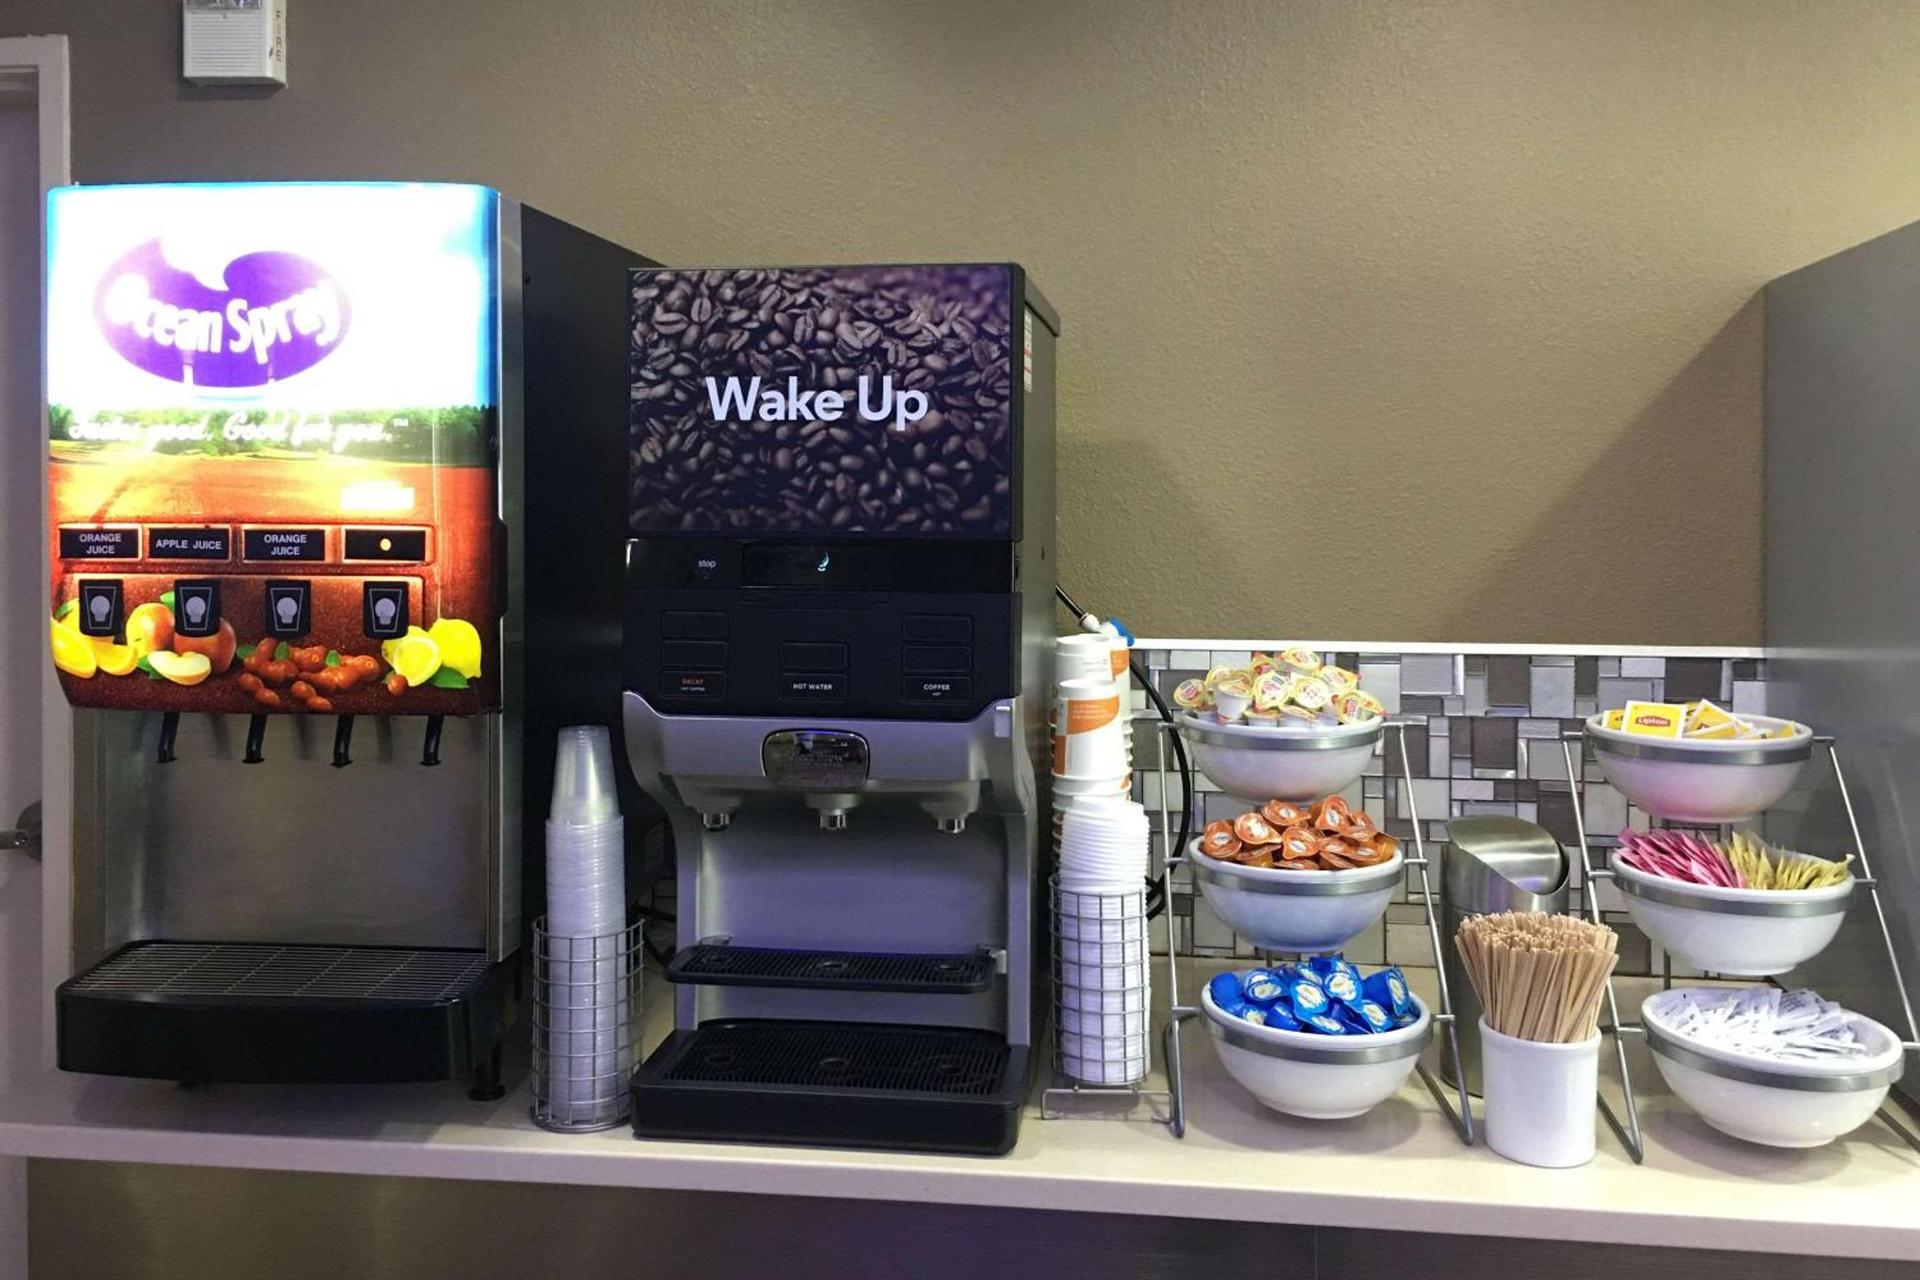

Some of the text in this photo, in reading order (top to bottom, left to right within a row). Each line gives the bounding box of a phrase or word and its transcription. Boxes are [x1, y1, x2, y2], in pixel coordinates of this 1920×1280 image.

[104, 272, 340, 365] Ocean Spray
[705, 375, 929, 431] Wake Up
[79, 533, 122, 543] ORANGE
[264, 534, 307, 544] ORANGE
[155, 539, 222, 550] APPLE JUICE
[86, 545, 115, 555] JUICE
[270, 546, 301, 556] JUICE
[698, 559, 717, 569] stop
[808, 683, 833, 691] WATER
[923, 683, 951, 691] COFFEE
[1637, 717, 1669, 727] Lipton
